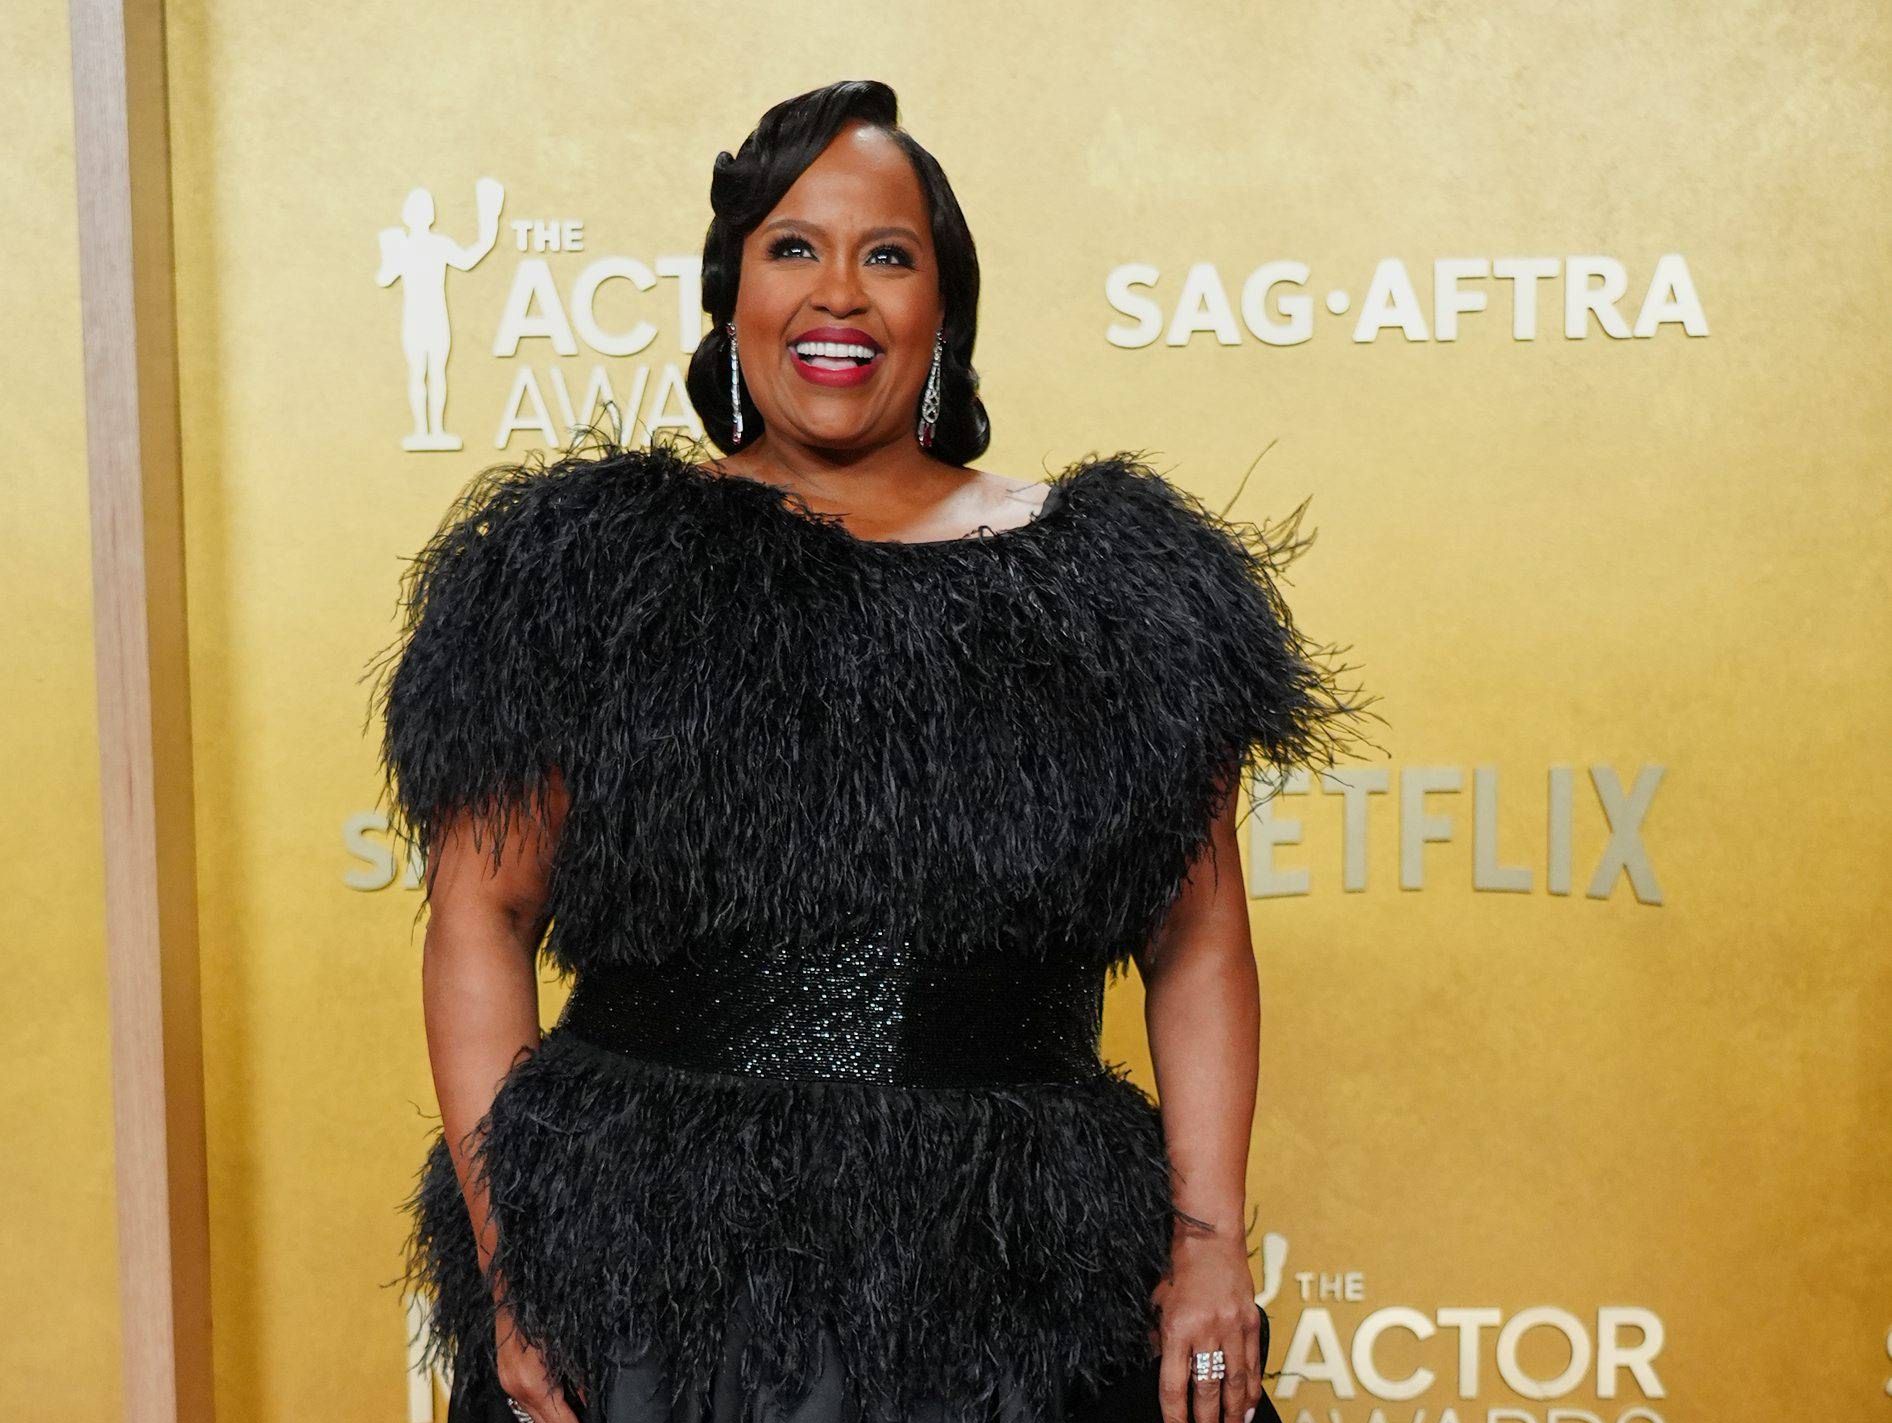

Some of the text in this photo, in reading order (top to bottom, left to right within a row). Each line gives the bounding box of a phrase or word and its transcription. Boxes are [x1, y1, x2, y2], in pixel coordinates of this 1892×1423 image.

[511, 219, 585, 253] THE
[493, 255, 704, 358] ACT
[1294, 1271, 1366, 1302] THE
[1274, 1305, 1667, 1400] ACTOR
